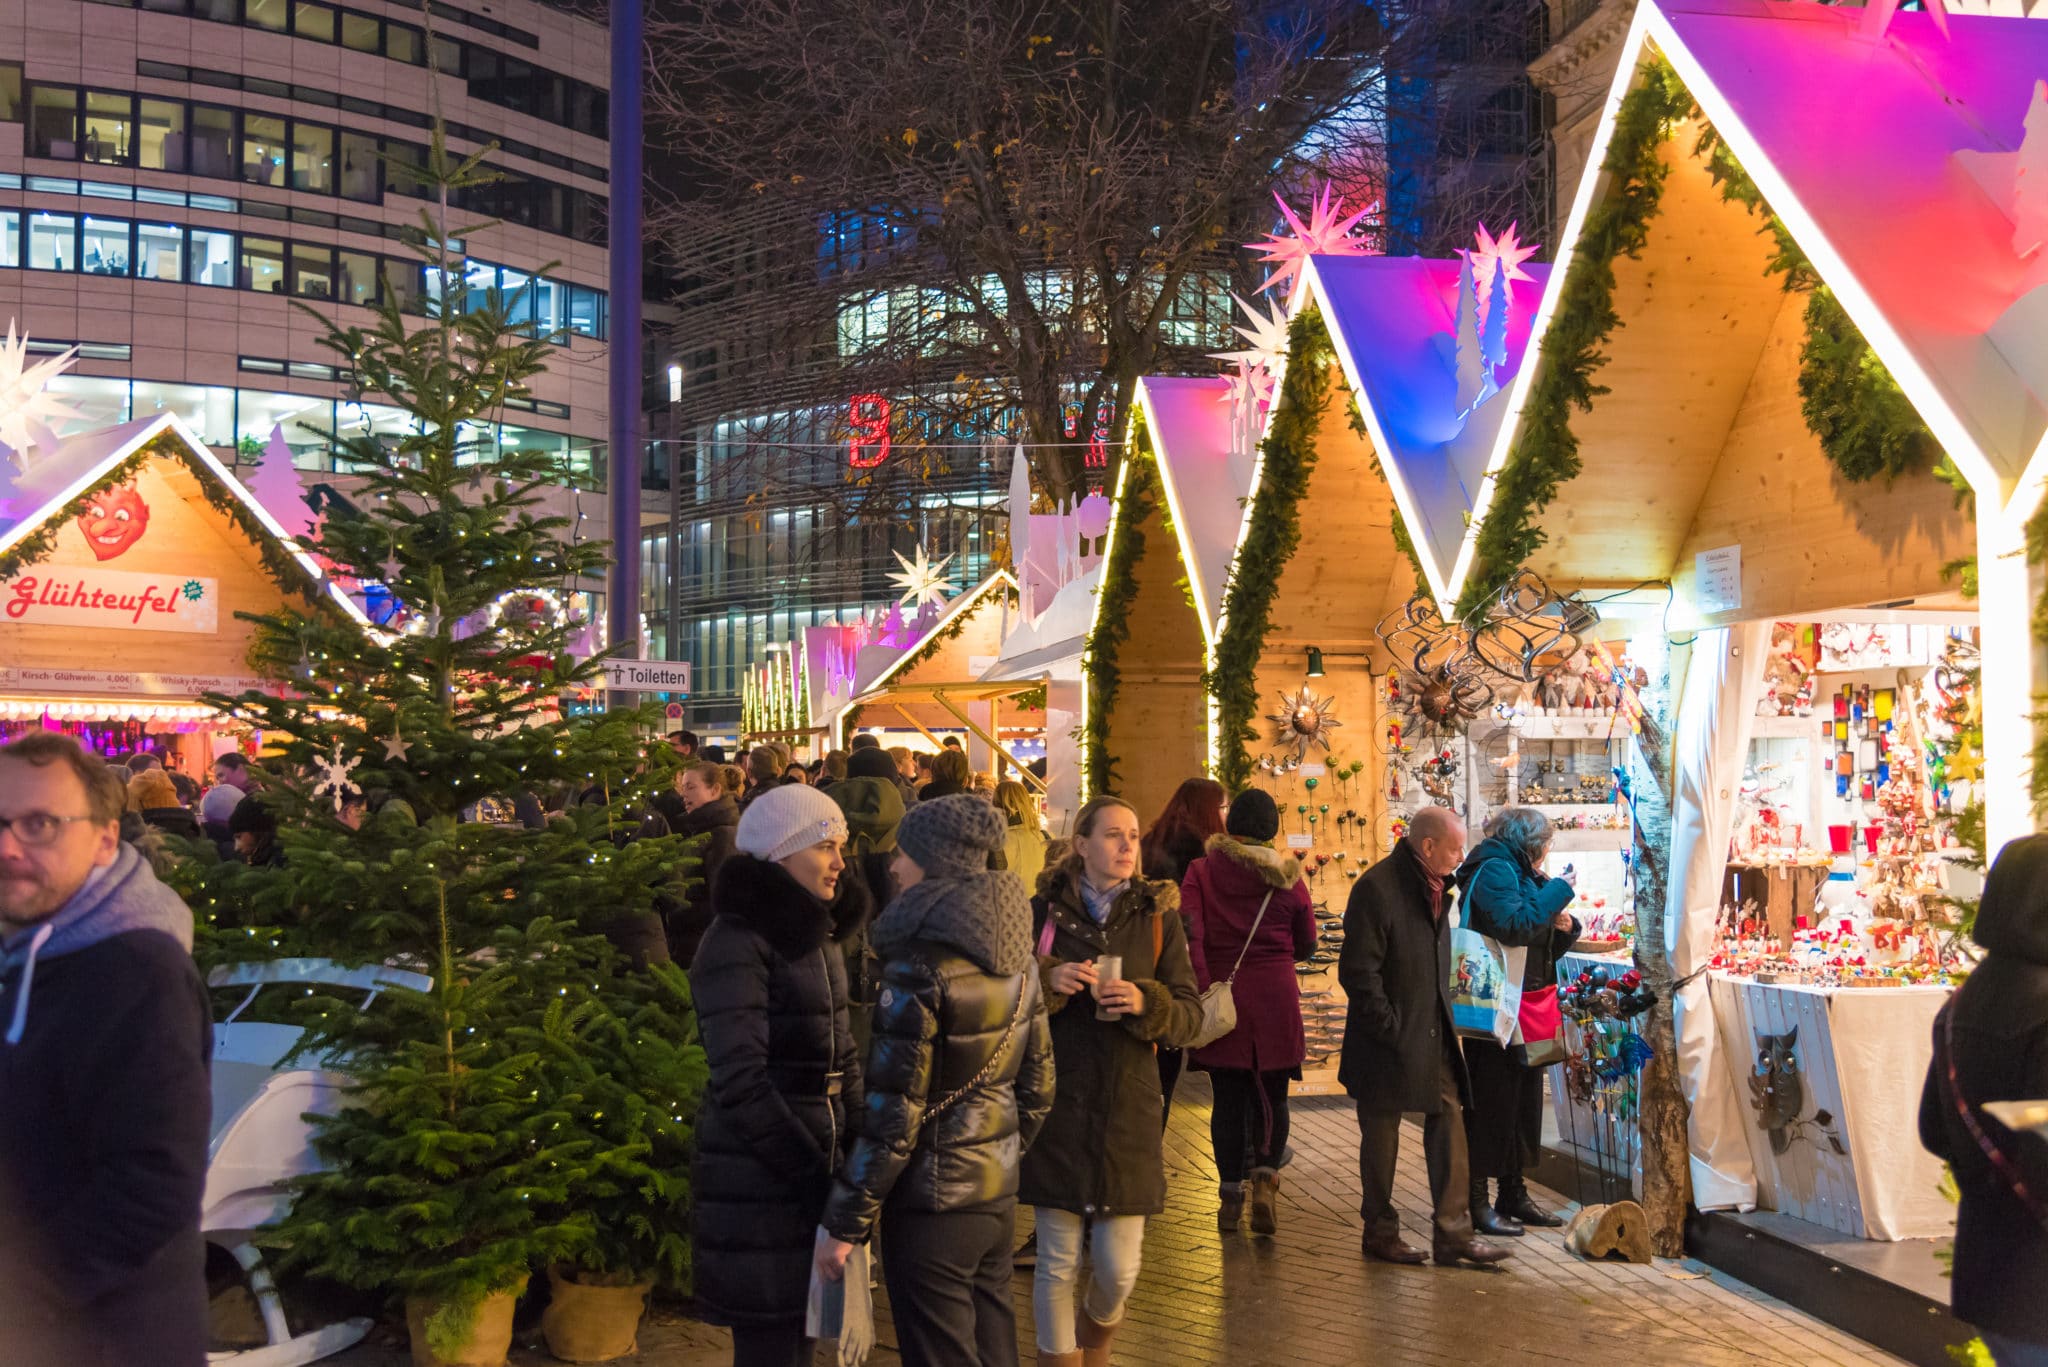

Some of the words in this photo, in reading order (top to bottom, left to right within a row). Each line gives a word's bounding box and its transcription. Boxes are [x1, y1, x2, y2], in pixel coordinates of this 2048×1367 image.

[6, 576, 180, 624] Glühteufel
[54, 672, 96, 682] Glühwein
[628, 667, 686, 685] Toiletten
